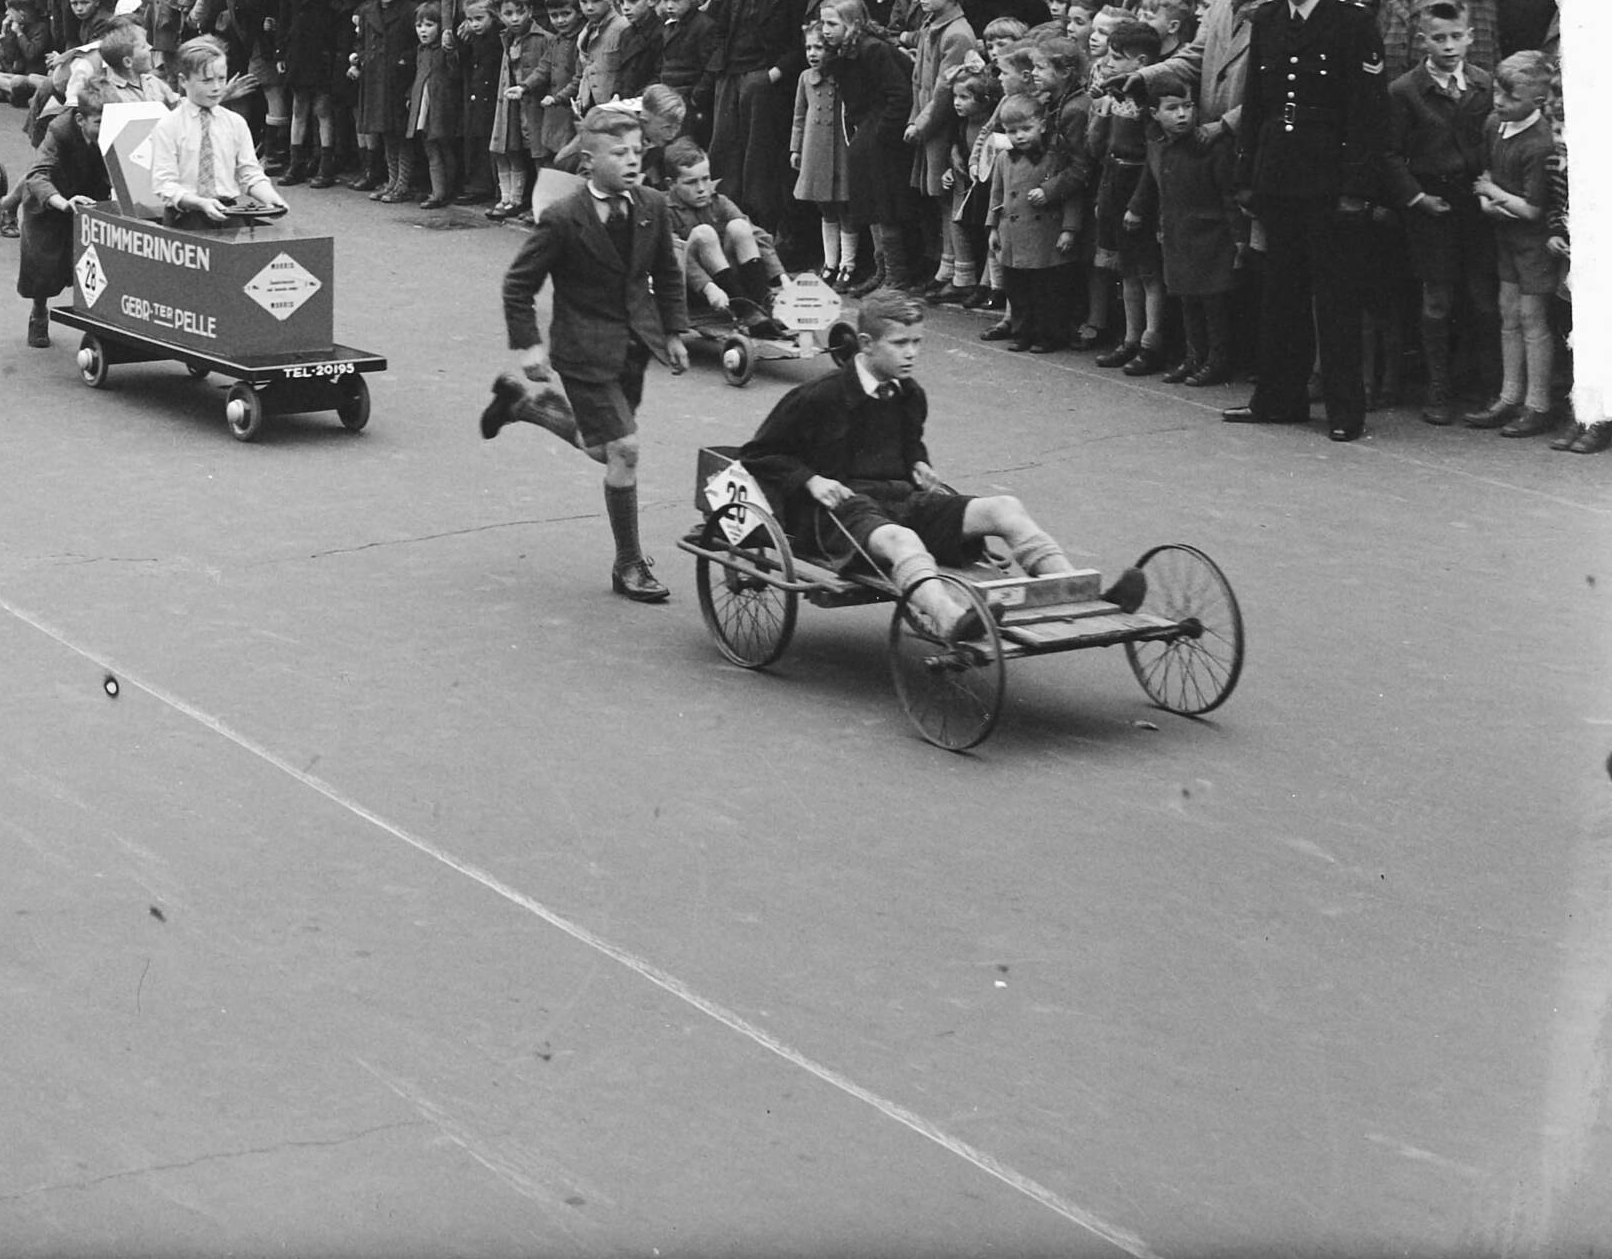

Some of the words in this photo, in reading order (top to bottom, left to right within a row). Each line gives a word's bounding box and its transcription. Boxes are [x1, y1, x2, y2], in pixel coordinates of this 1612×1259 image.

[80, 213, 210, 272] BETIMMERINGEN
[84, 259, 97, 292] 28
[153, 302, 173, 320] TER
[174, 308, 217, 339] PELLE
